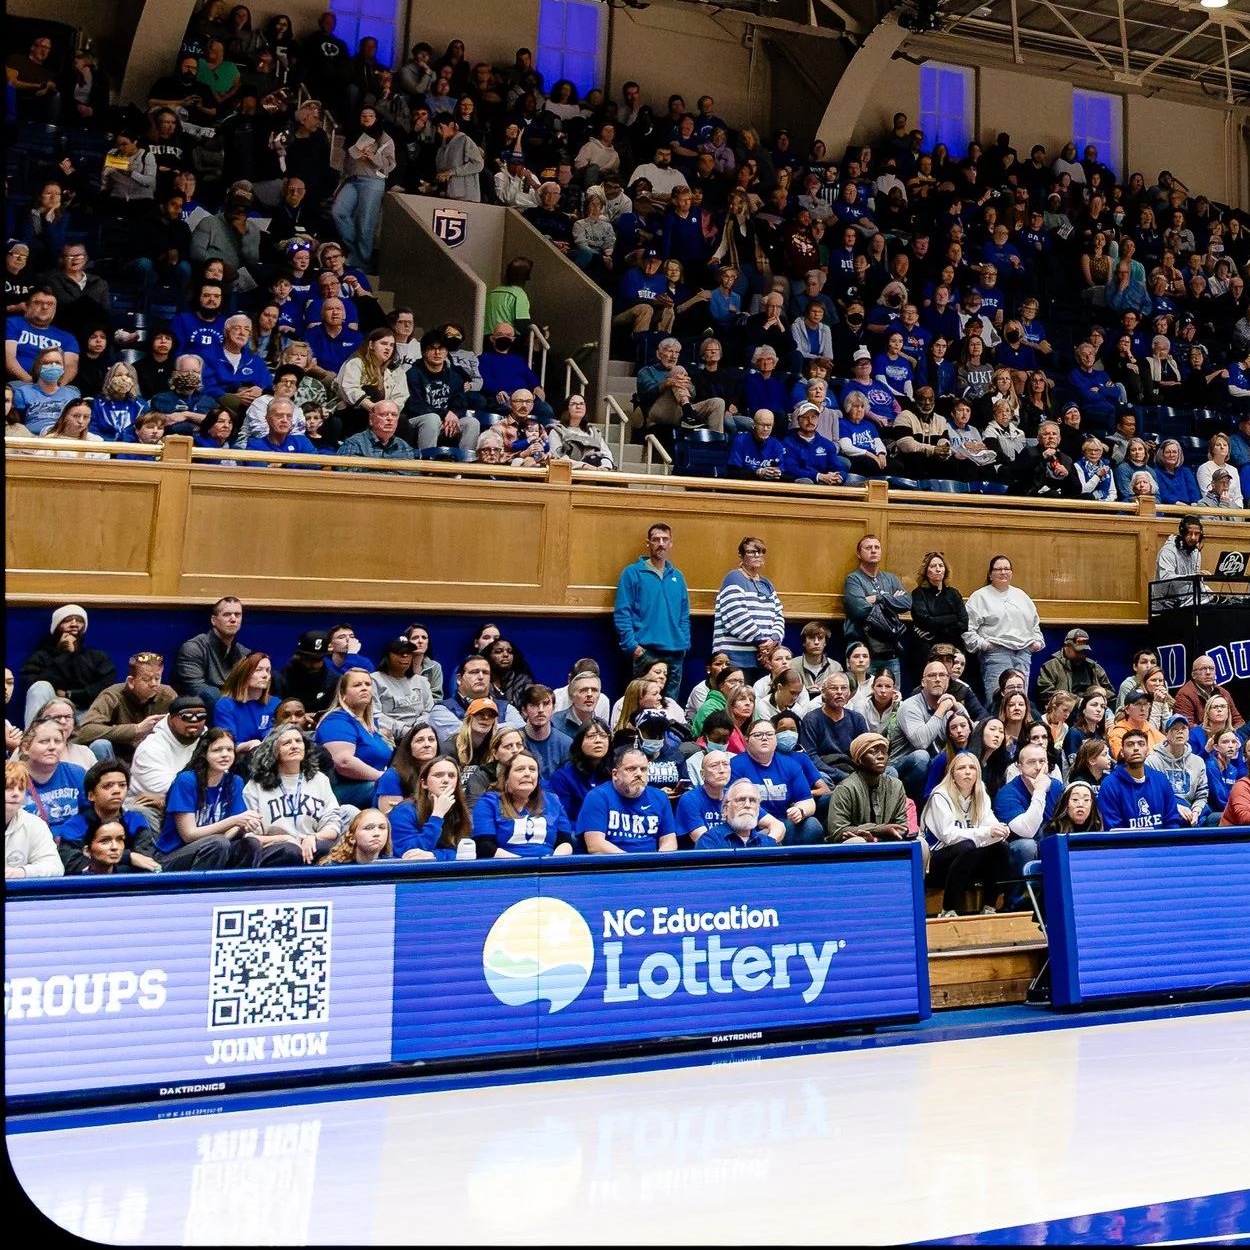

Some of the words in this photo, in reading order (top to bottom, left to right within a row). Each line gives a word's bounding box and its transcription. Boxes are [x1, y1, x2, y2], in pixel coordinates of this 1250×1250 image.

[439, 218, 461, 239] 15
[608, 810, 659, 835] DUKE
[1129, 814, 1162, 829] DUKE
[603, 908, 645, 938] NC
[653, 904, 779, 935] Education
[205, 1036, 266, 1065] JOIN
[272, 1031, 329, 1060] NOW
[711, 1032, 762, 1044] DAKTRONICS
[159, 1082, 226, 1097] DAKTRONICS
